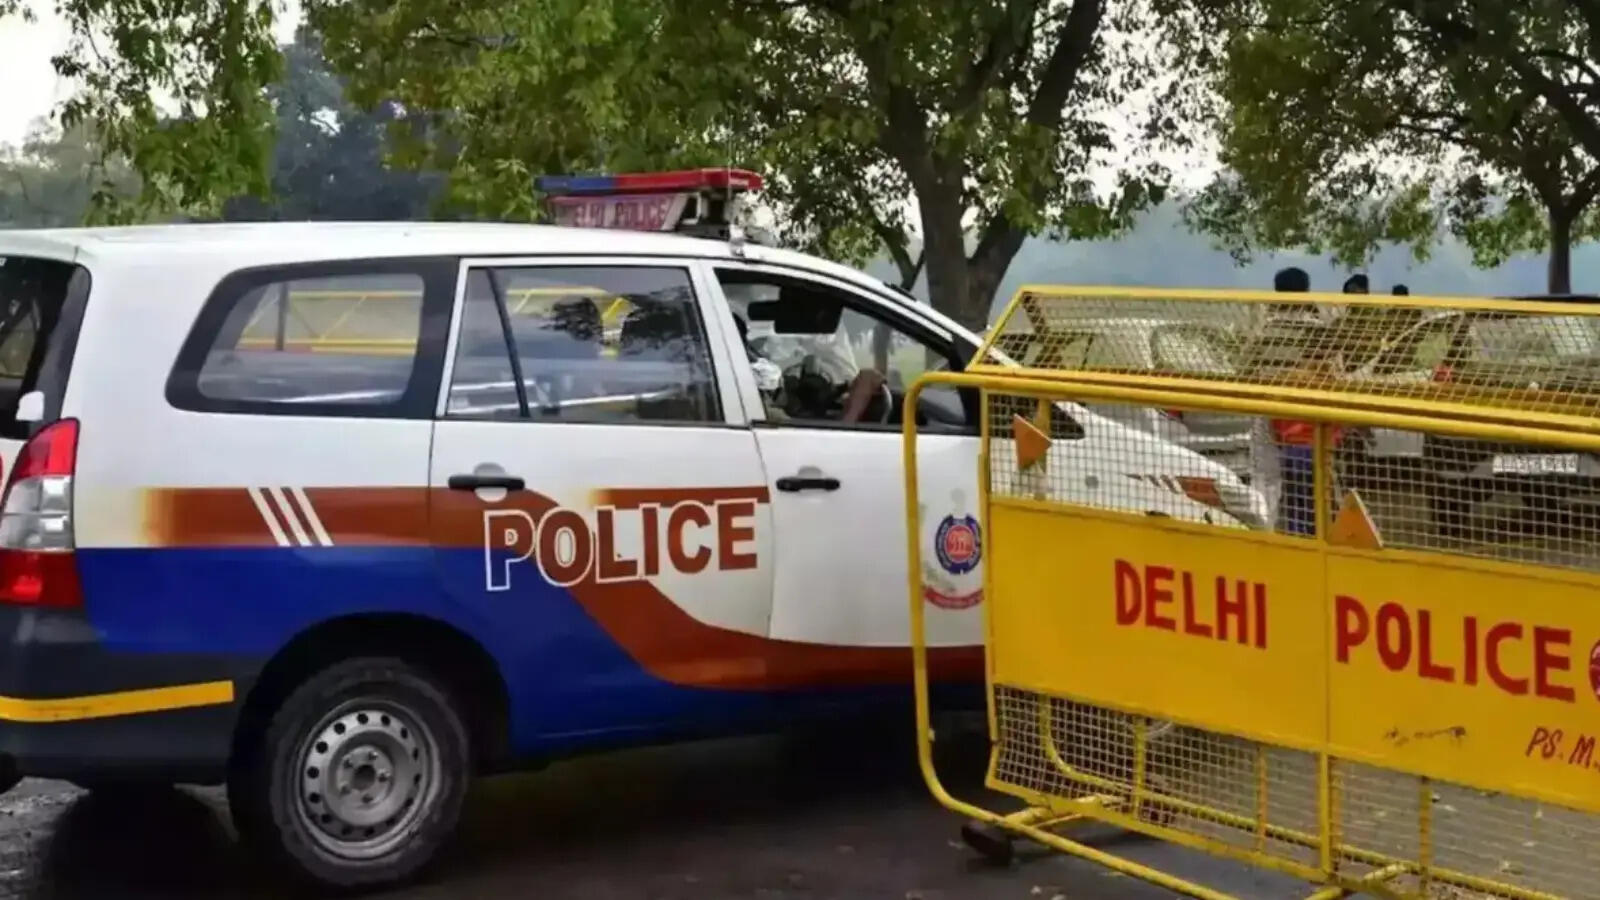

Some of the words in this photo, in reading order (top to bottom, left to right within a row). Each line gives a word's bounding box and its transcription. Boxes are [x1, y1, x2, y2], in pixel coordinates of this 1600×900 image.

[614, 199, 670, 230] POLICE
[485, 498, 757, 591] POLICE
[1114, 558, 1267, 650] DELHI
[1334, 595, 1576, 703] POLICE
